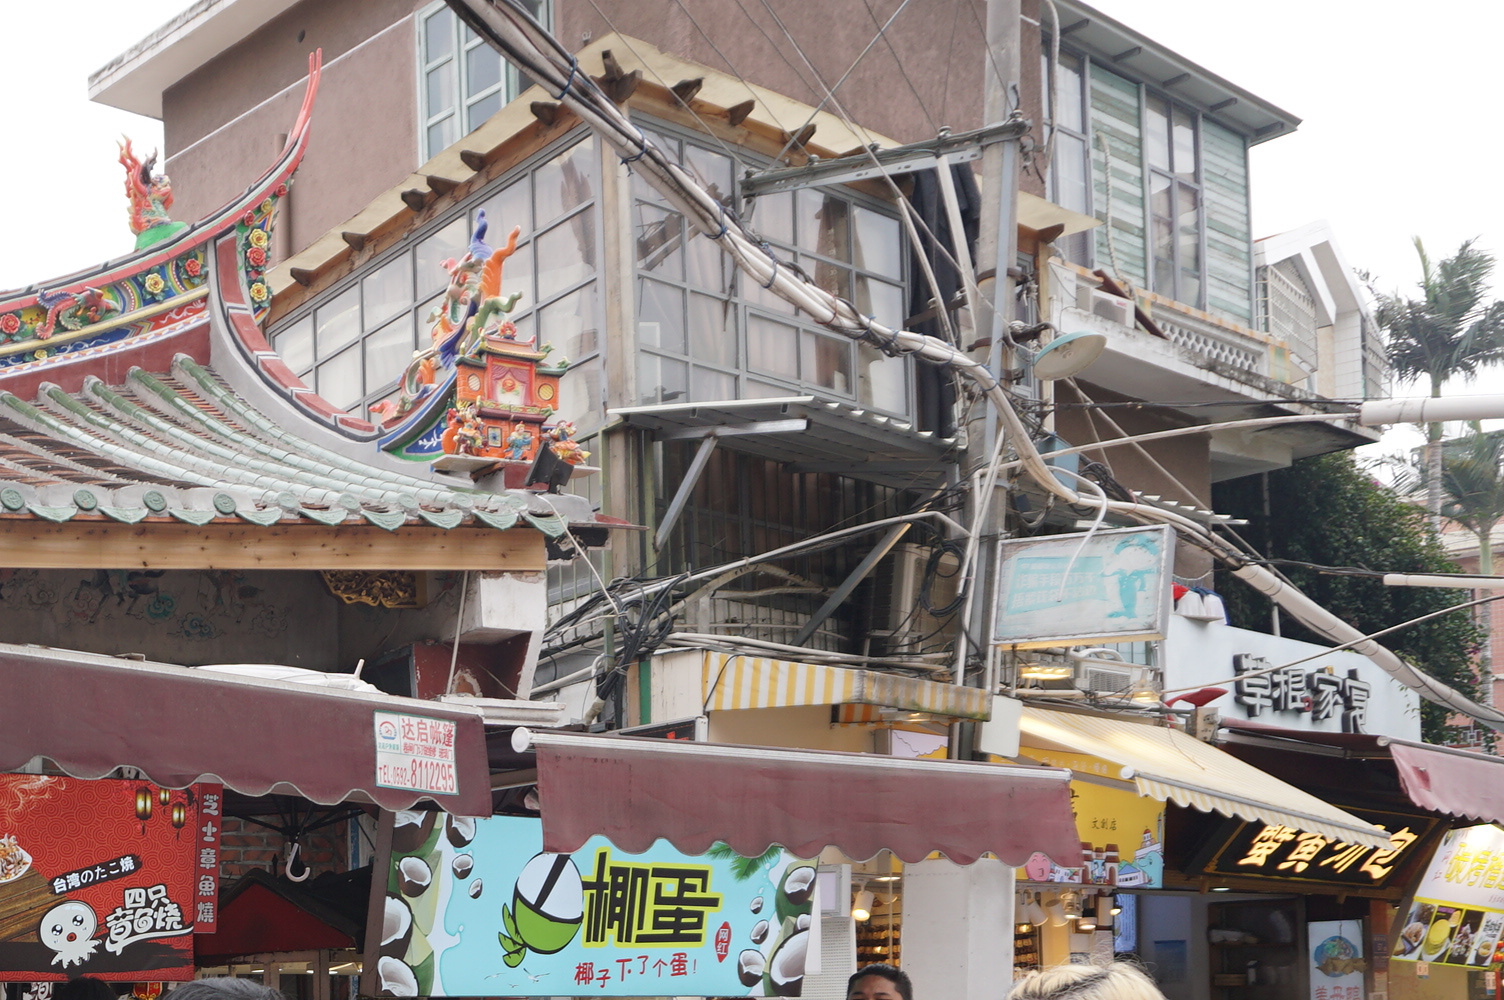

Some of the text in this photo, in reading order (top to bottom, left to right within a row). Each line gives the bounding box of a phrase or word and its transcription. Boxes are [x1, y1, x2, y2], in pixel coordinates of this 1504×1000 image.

[402, 718, 455, 747] 达启帐篷
[196, 794, 219, 924] 芝士章魚燒
[124, 885, 169, 909] 四只
[582, 851, 720, 944] 椰蛋
